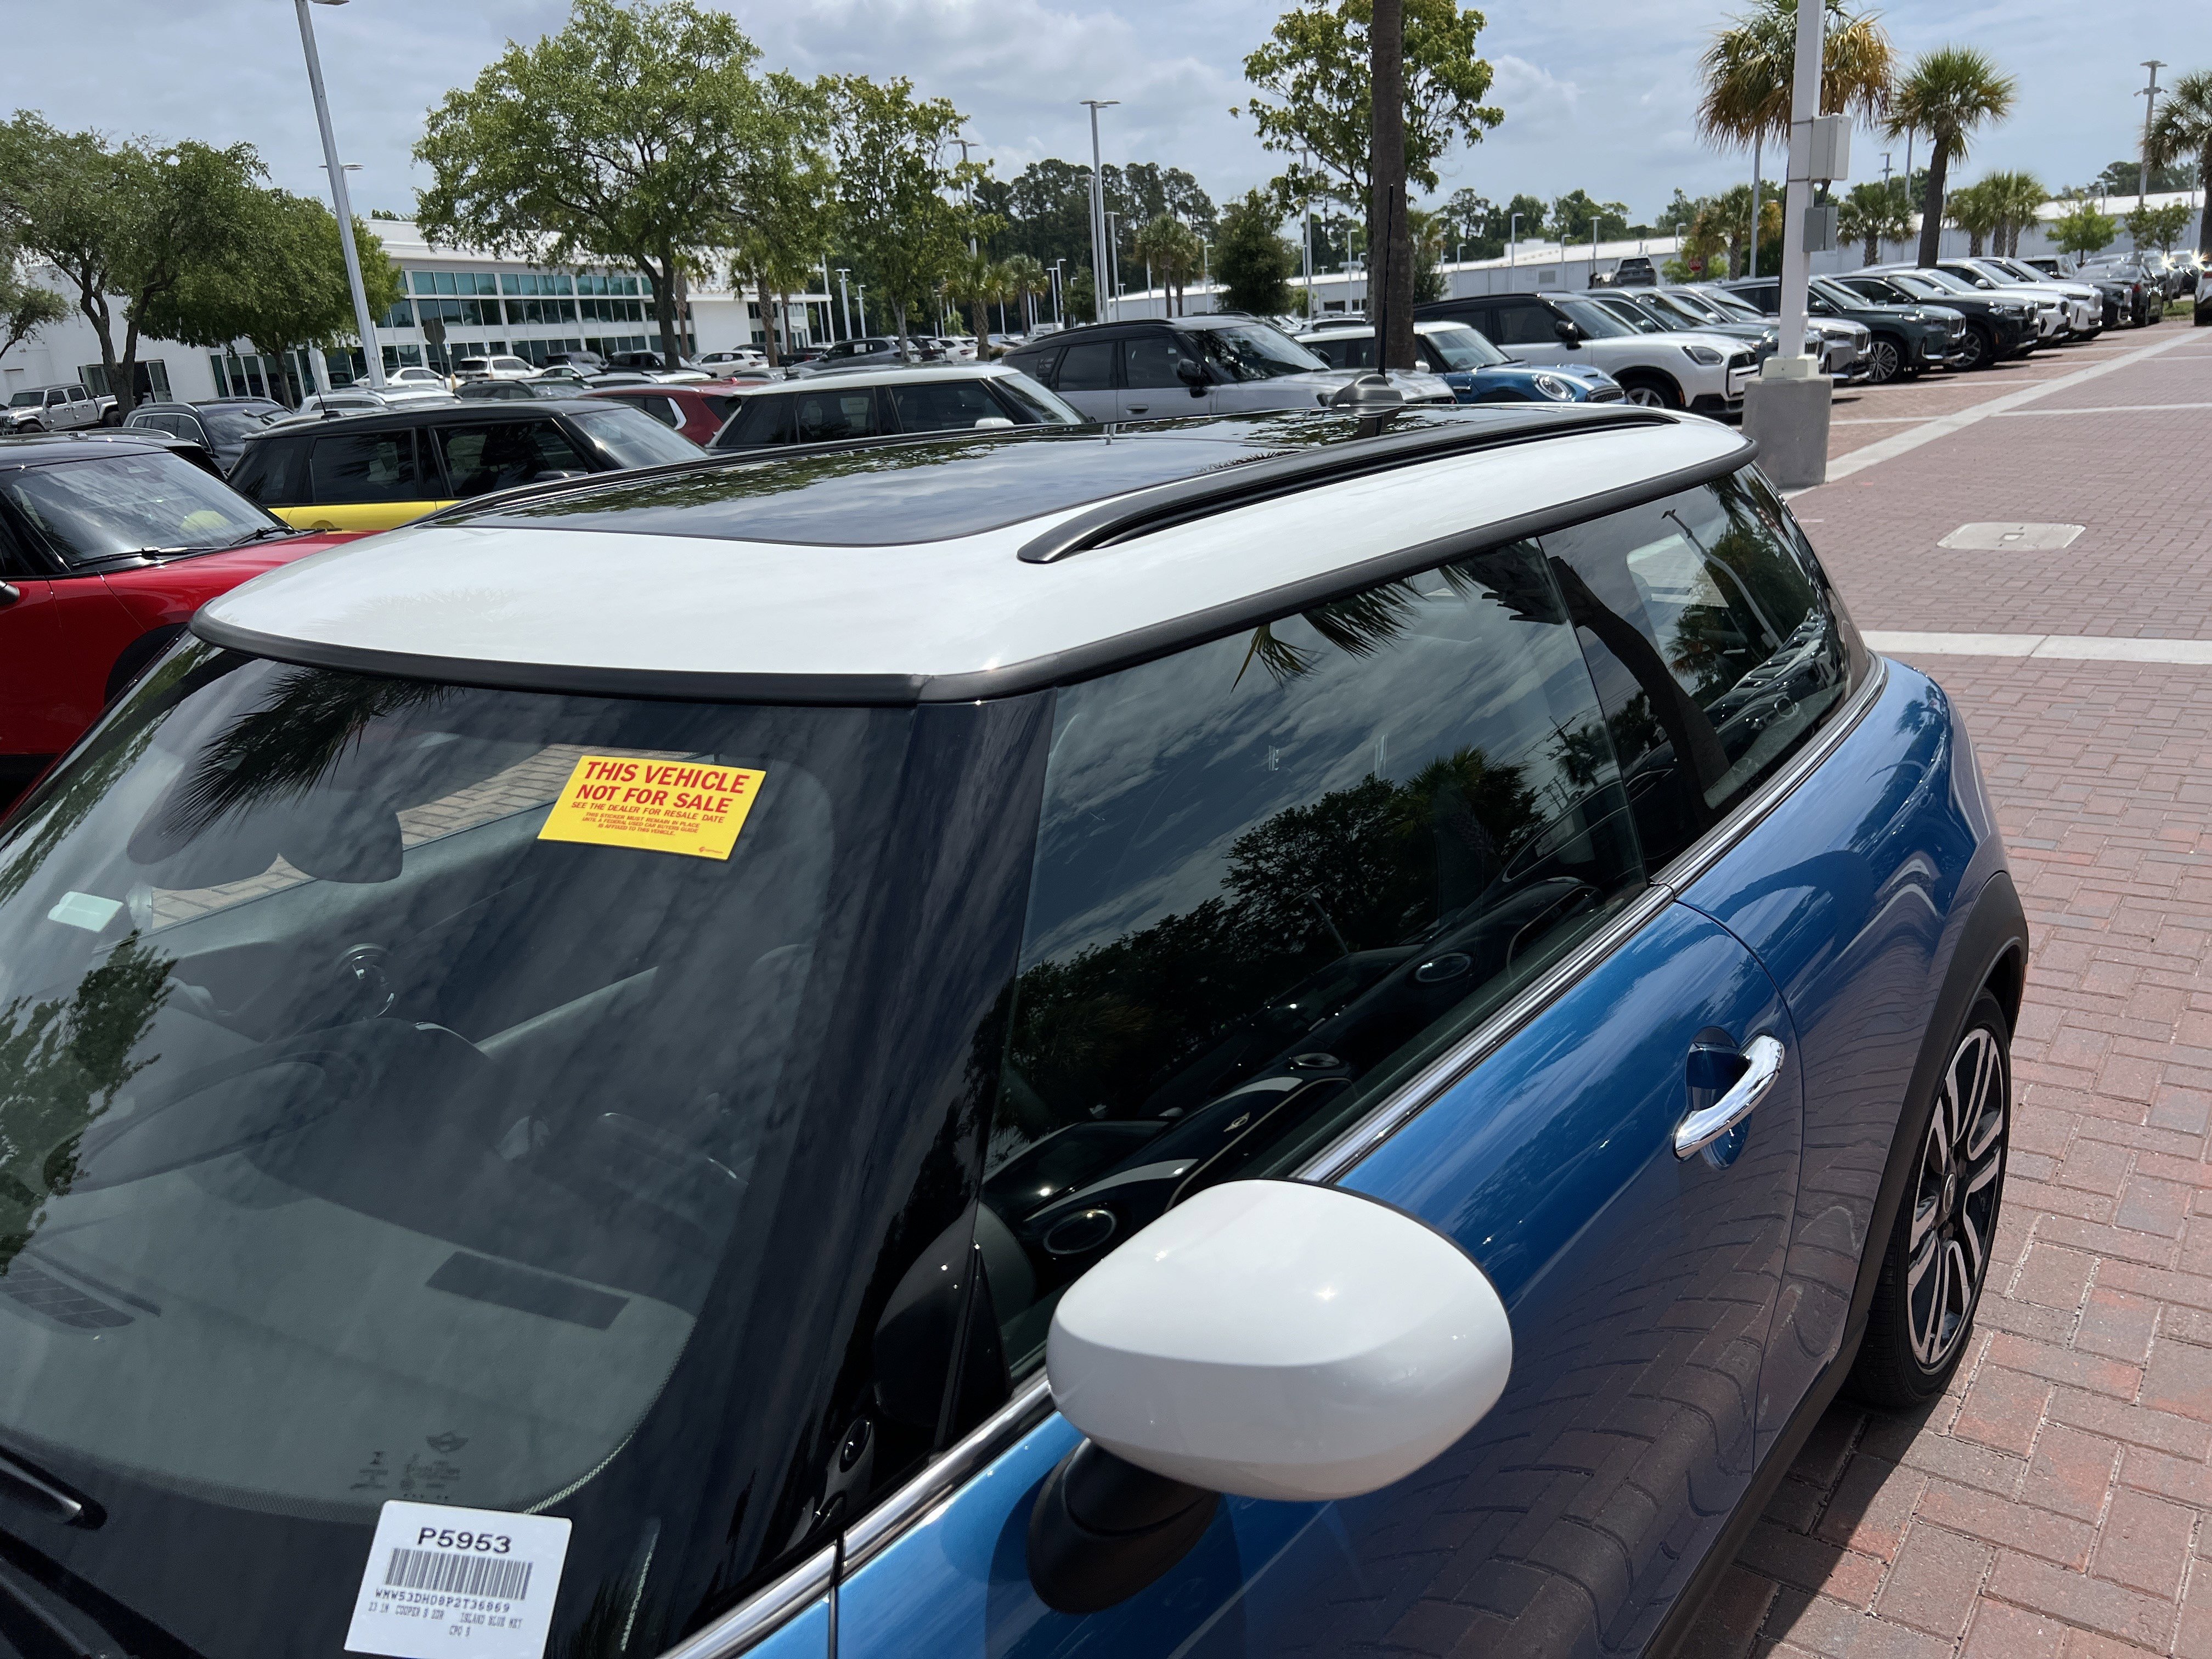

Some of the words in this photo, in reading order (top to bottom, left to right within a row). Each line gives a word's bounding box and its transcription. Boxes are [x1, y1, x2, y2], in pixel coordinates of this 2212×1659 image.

[585, 761, 639, 782] THIS
[645, 765, 750, 794] VEHICLE
[575, 784, 622, 801] NOT
[622, 787, 669, 806] FOR
[673, 792, 733, 814] SALE
[607, 804, 641, 813] DEALER
[663, 809, 699, 820] RESALE
[701, 814, 725, 823] DATE
[417, 1527, 511, 1554] P5953
